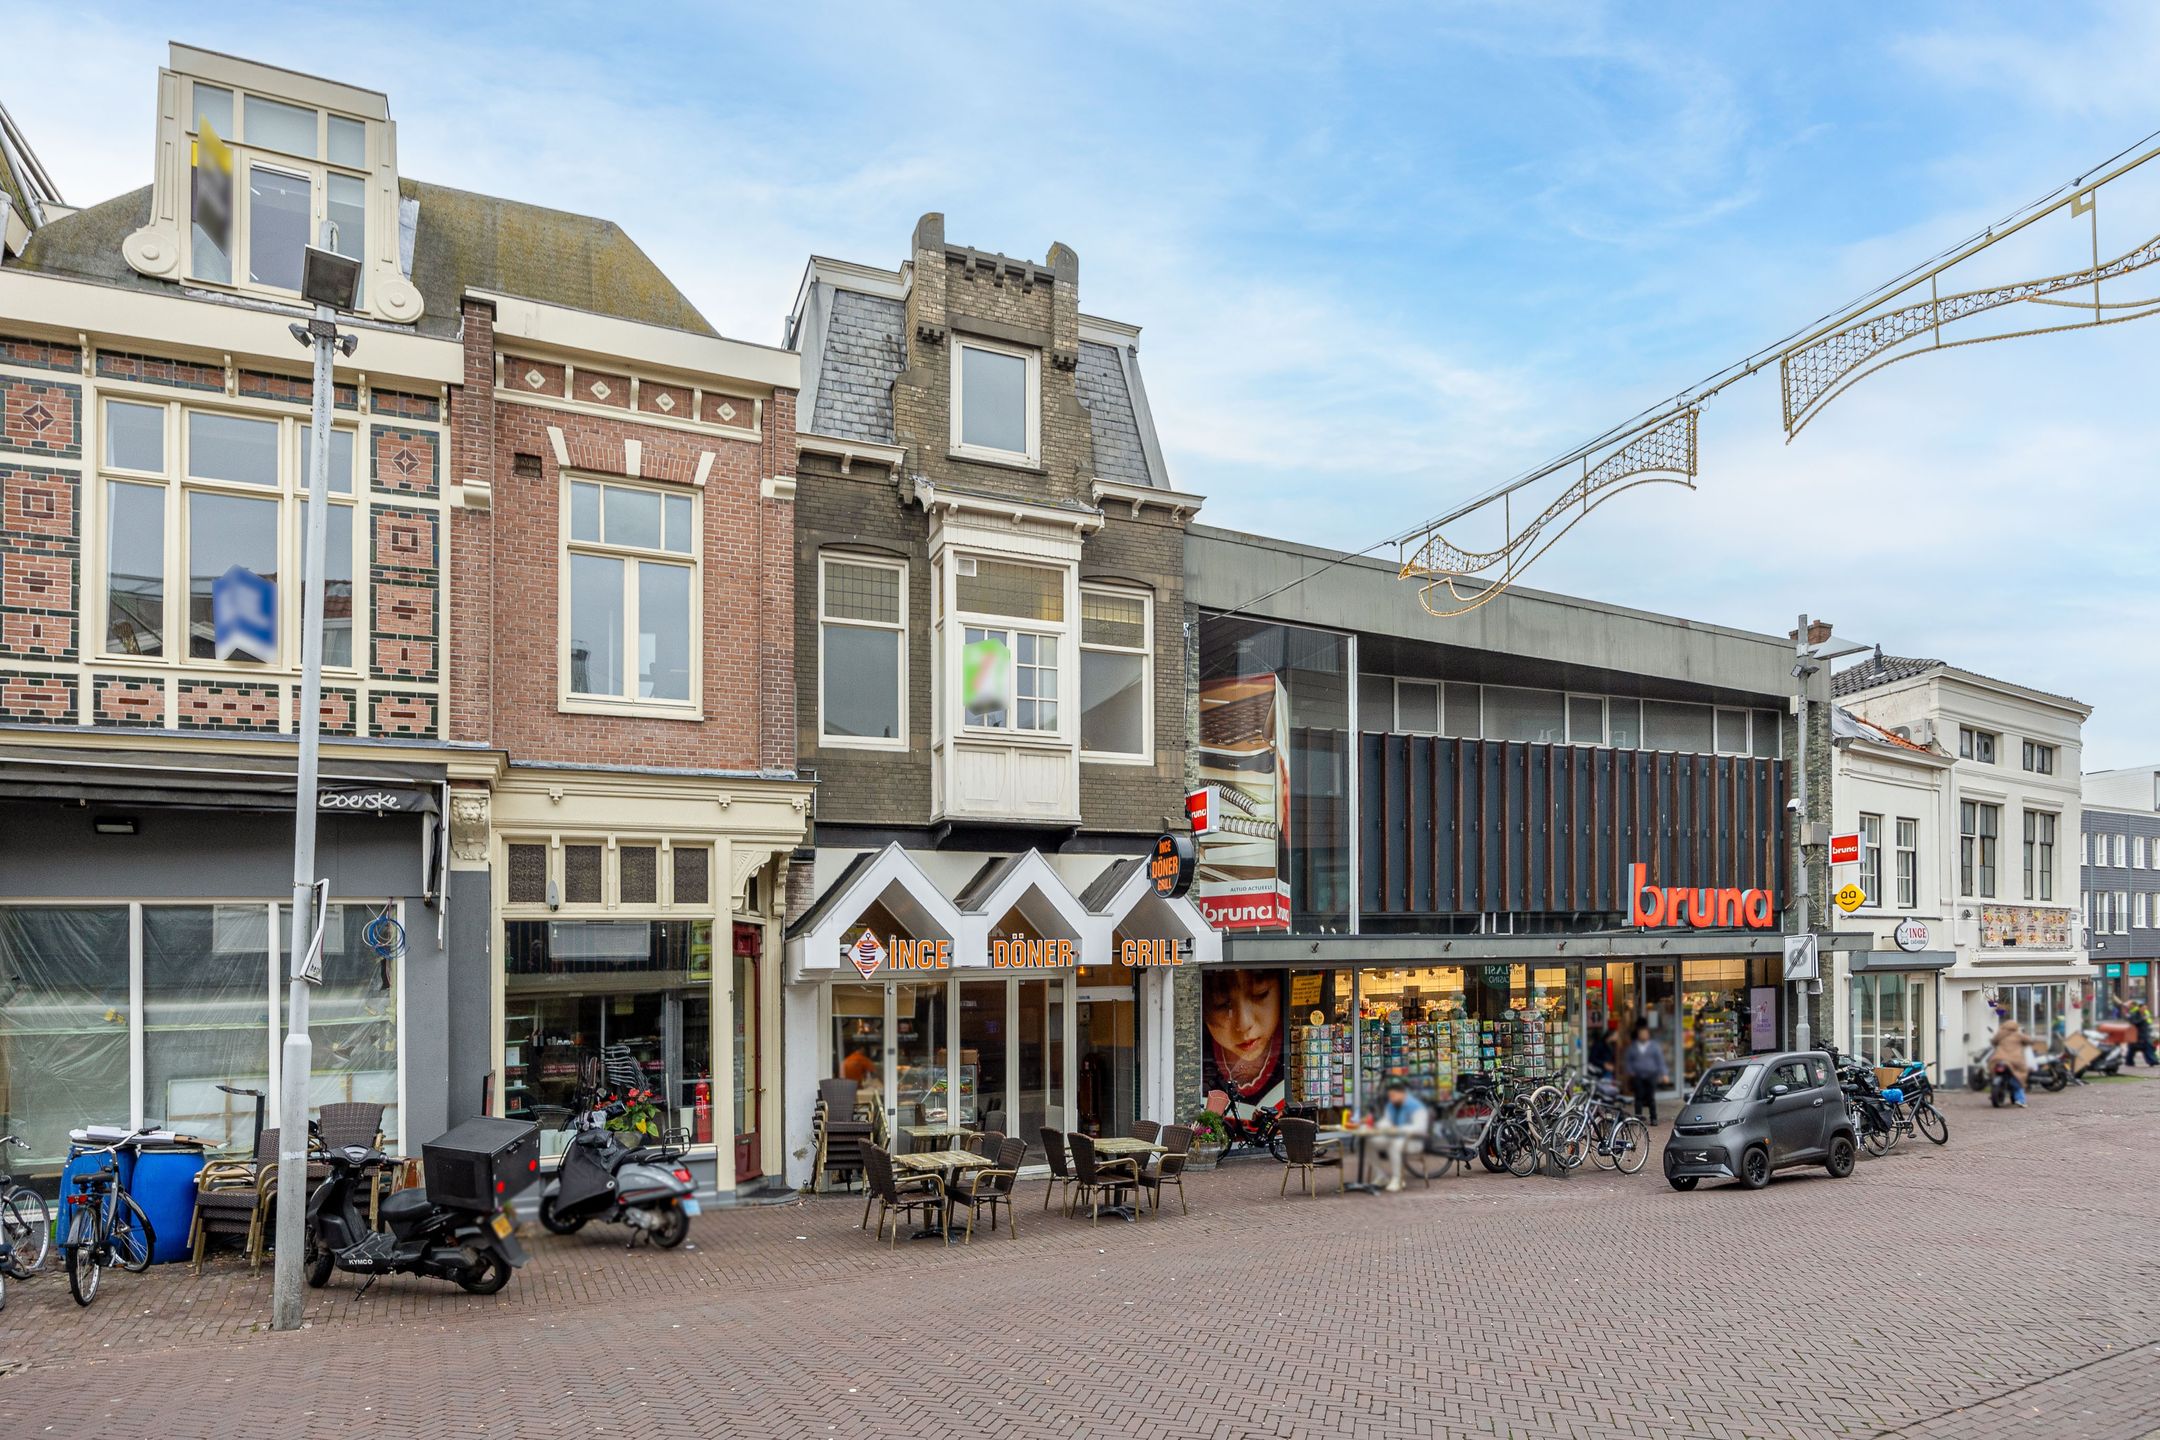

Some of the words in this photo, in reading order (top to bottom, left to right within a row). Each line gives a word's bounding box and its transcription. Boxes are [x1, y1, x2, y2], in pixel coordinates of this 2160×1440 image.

[1191, 808, 1207, 819] runa
[1832, 846, 1857, 855] bruna
[1151, 855, 1178, 879] DÖNER
[1630, 863, 1773, 928] bruna
[1202, 902, 1272, 923] bruna
[993, 933, 1073, 968] DÖNER
[1121, 939, 1184, 966] GRILL
